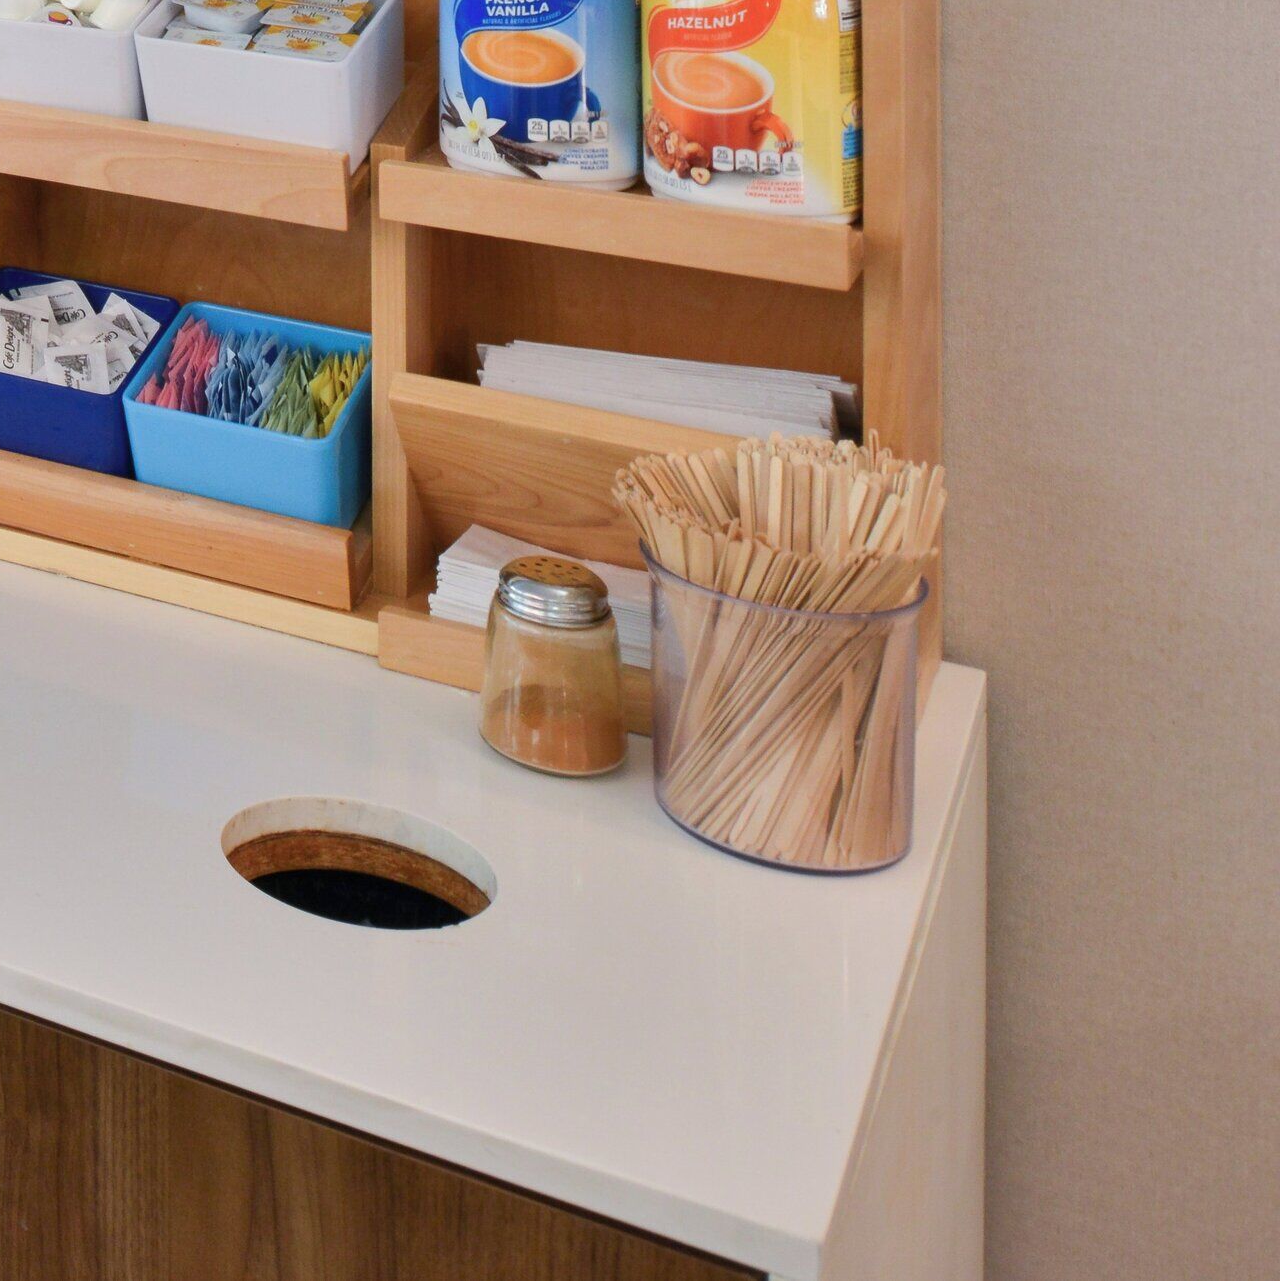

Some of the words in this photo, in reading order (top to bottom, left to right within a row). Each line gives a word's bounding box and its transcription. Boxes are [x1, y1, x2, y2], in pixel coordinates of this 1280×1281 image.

[486, 2, 550, 17] VANILLA
[667, 9, 748, 30] HAZELNUT
[531, 121, 543, 130] 25
[716, 149, 728, 159] 25
[3, 352, 15, 370] Café
